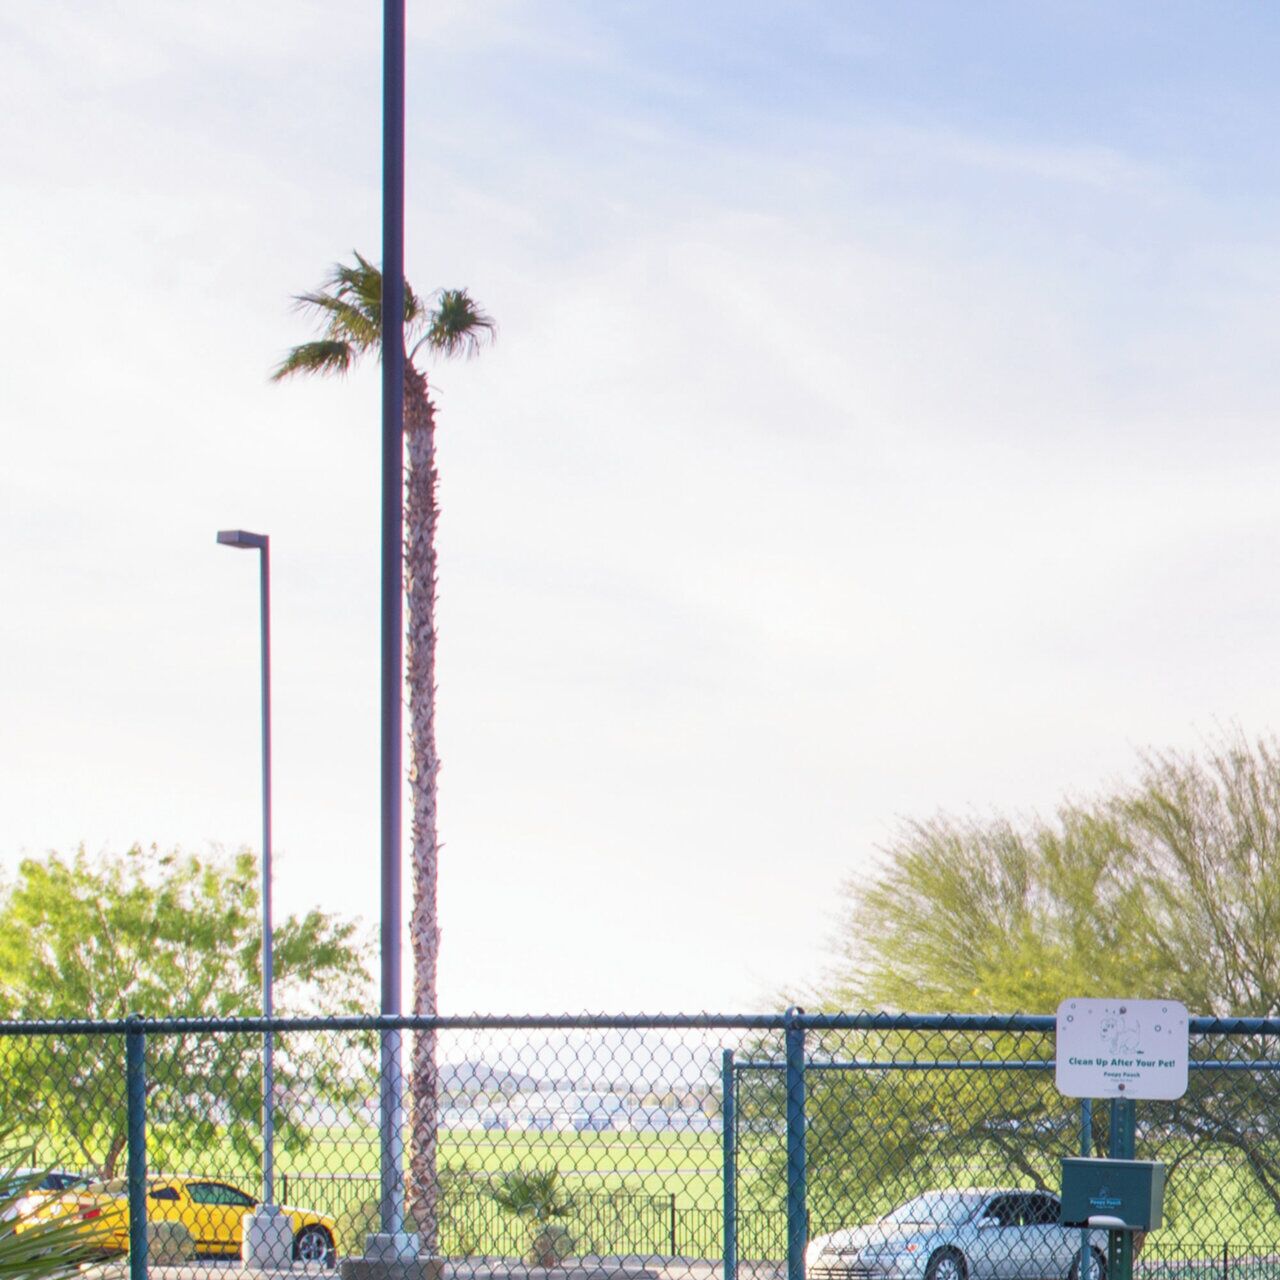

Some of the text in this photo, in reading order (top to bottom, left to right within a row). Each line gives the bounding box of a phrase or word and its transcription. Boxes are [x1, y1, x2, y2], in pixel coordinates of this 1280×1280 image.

[1068, 1057, 1176, 1068] Clean Up After Your Pet!
